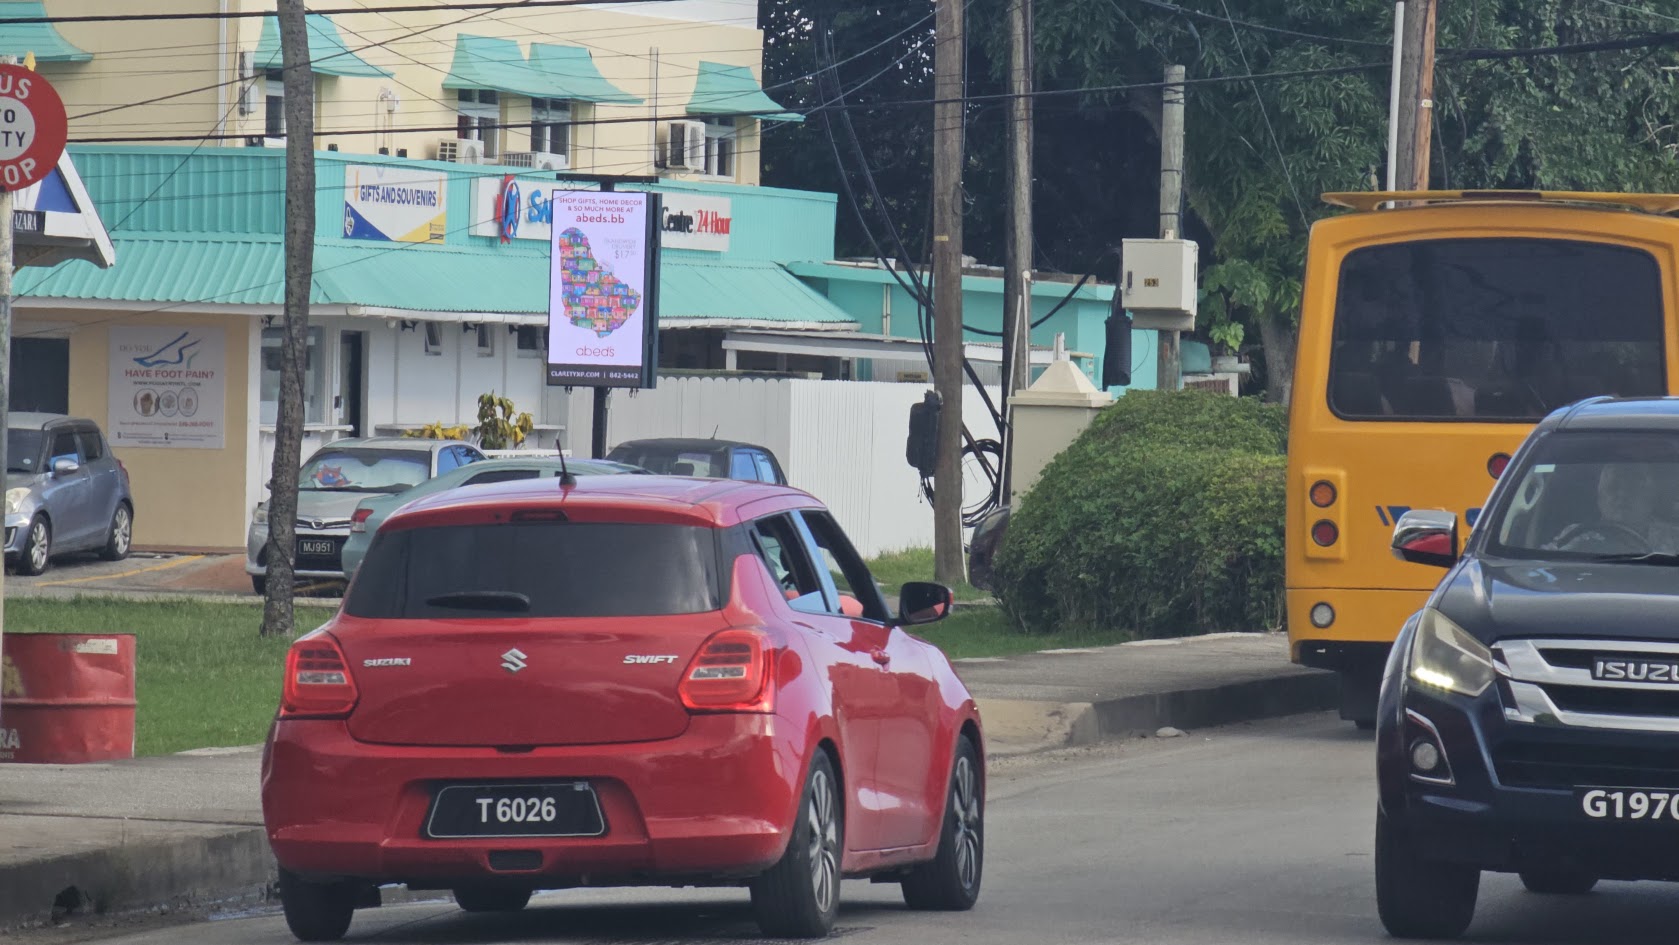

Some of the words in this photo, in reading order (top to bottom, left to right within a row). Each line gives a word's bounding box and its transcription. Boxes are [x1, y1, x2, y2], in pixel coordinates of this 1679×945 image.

[0, 109, 15, 123] O
[0, 158, 36, 185] OP
[361, 184, 380, 202] GIFTS
[380, 187, 396, 204] AND
[397, 188, 436, 207] SOUVENIRS
[576, 213, 625, 224] abeds.bb
[661, 206, 693, 233] Centre
[697, 208, 708, 233] 24
[710, 210, 732, 234] Hour
[125, 369, 152, 378] HAVE
[155, 370, 183, 379] FOOT
[185, 370, 214, 380] PAIN?
[551, 370, 600, 378] CLARITYXP.COM
[303, 542, 330, 553] MJ951
[363, 657, 412, 667] SUZUKI
[623, 655, 678, 664] SWIFT
[475, 798, 494, 822] T
[496, 797, 557, 822] 6026
